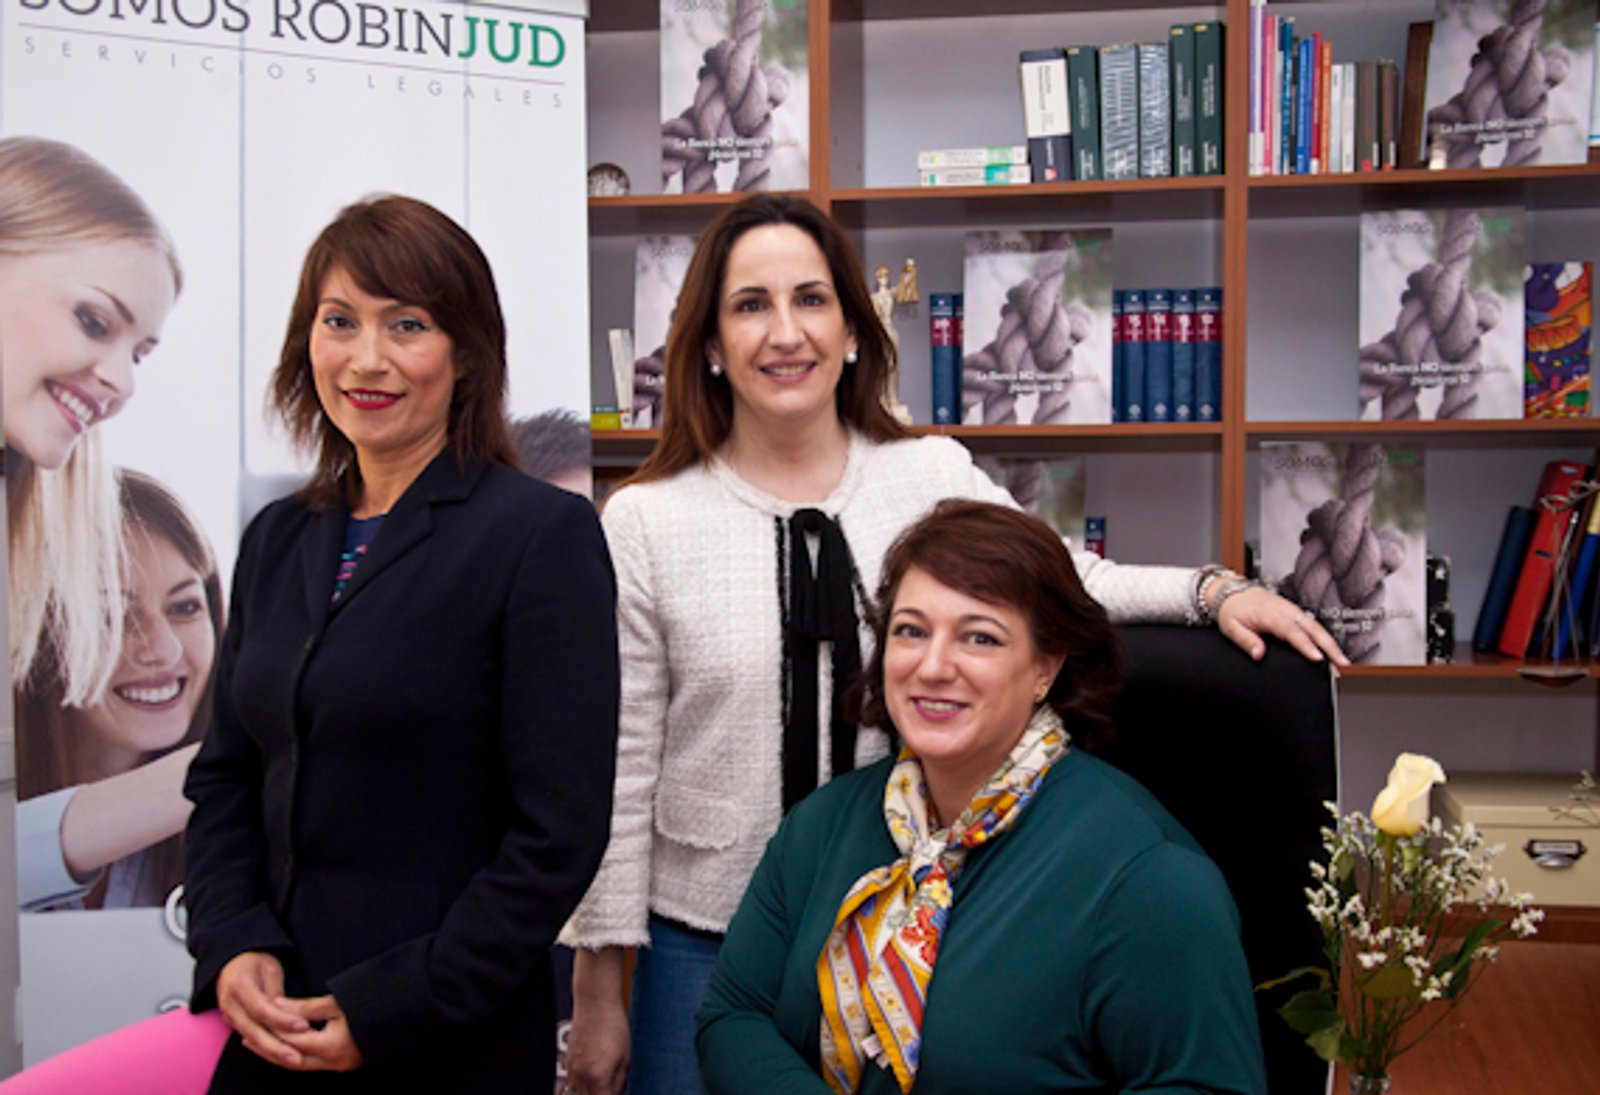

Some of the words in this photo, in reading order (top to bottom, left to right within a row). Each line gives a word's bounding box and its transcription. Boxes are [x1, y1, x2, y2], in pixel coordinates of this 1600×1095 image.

[19, 0, 250, 32] MOS
[270, 0, 566, 67] ROBINJUD
[24, 36, 317, 83] SERVICIOS
[367, 74, 562, 108] LEGALES
